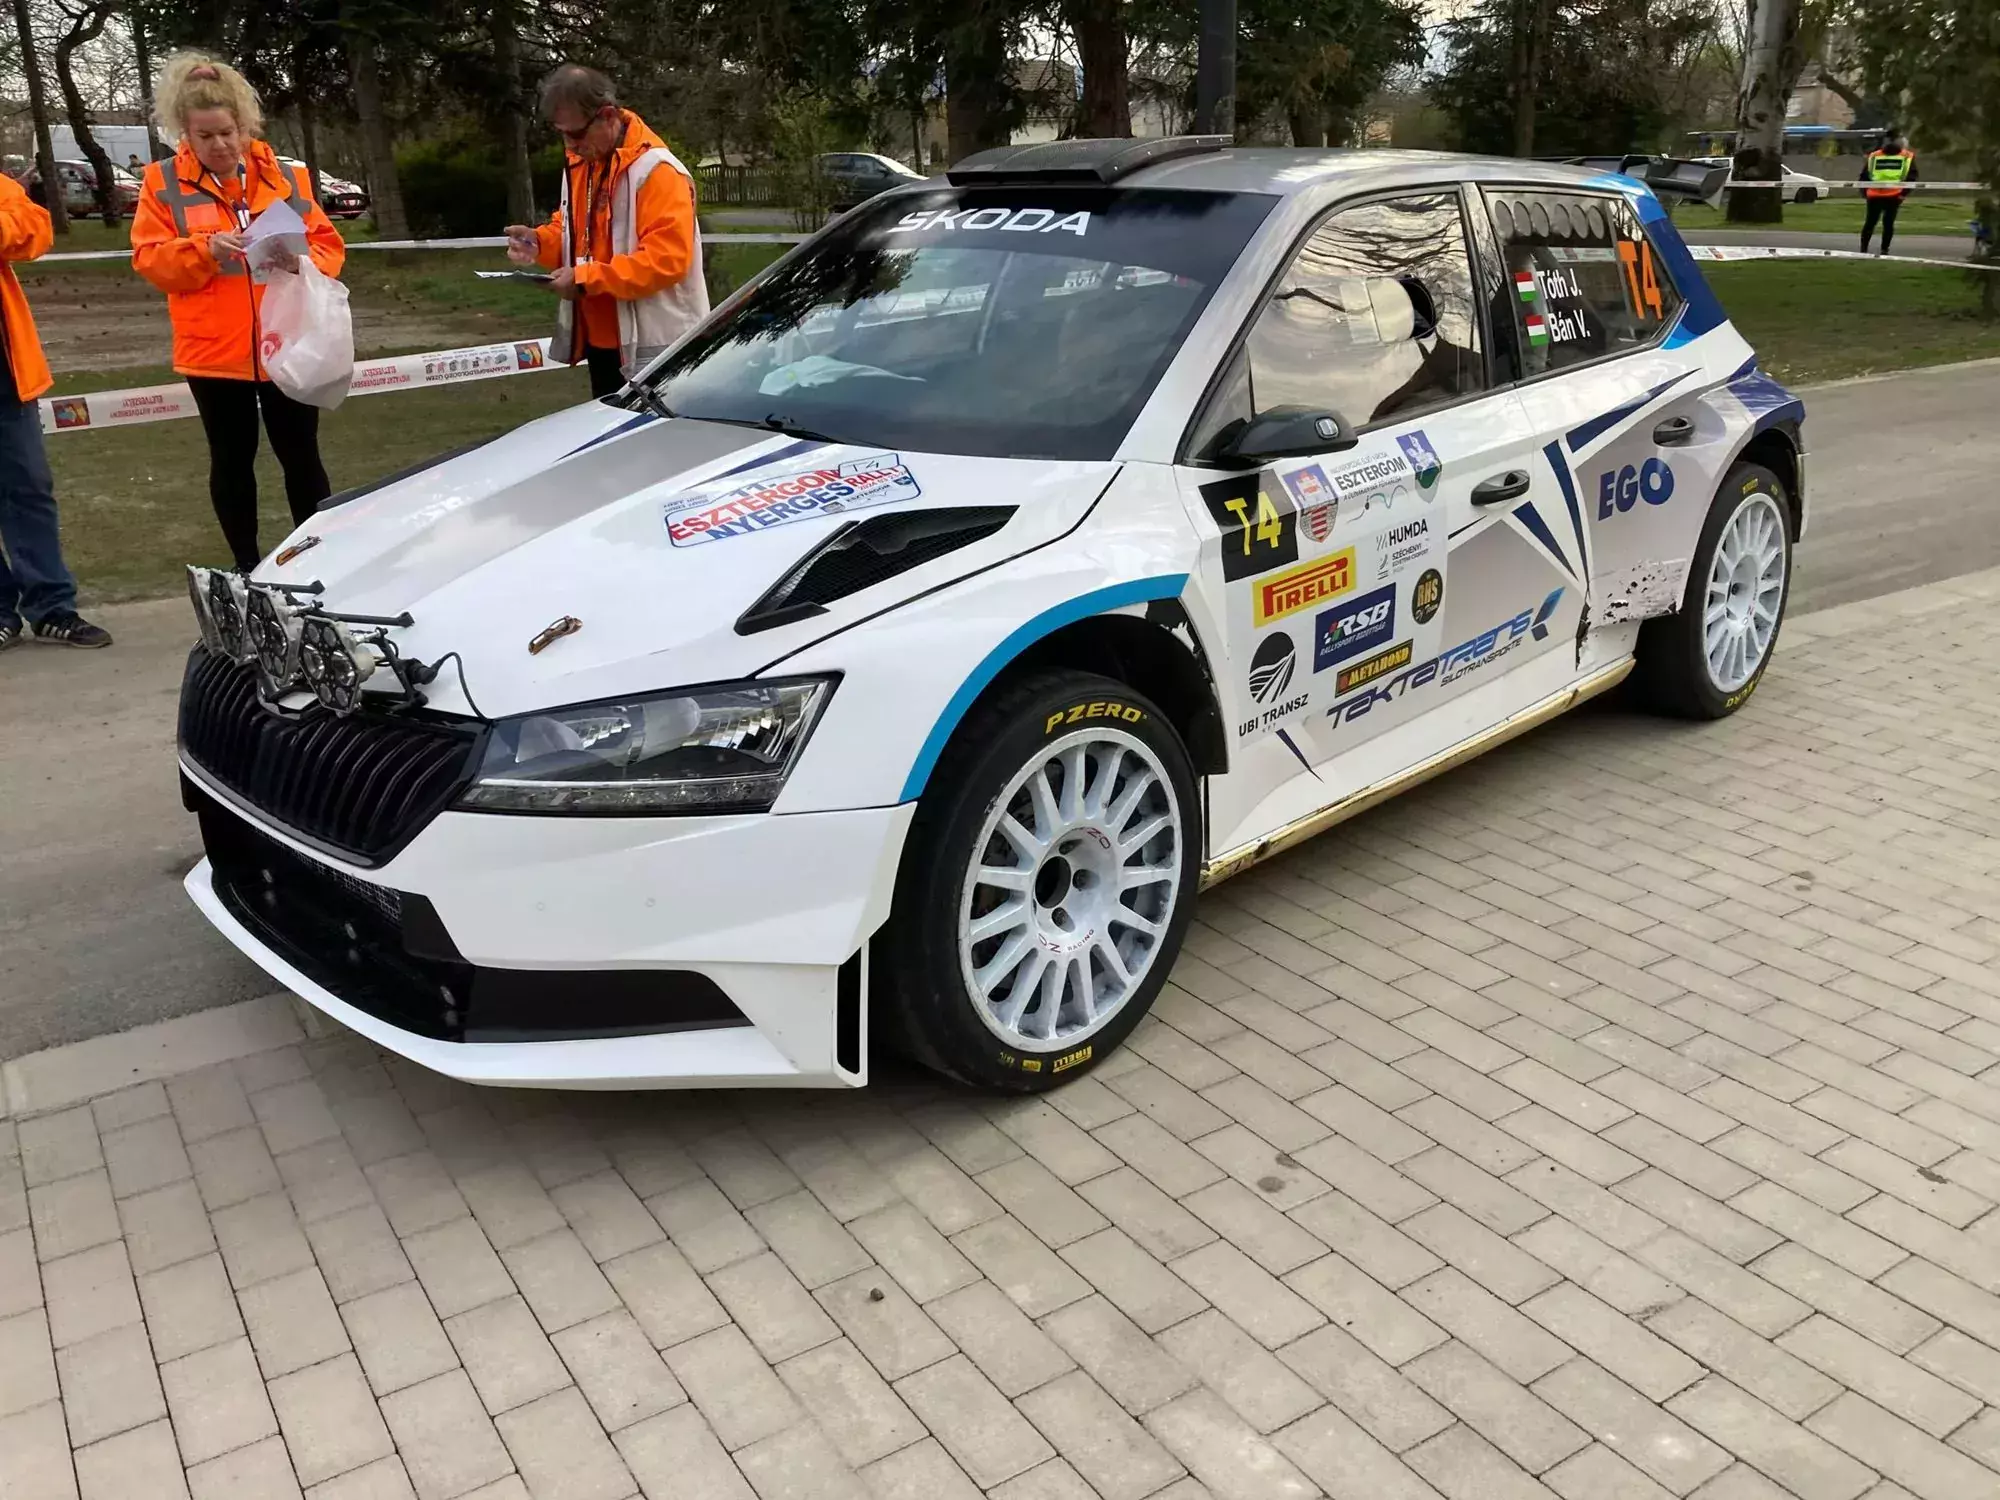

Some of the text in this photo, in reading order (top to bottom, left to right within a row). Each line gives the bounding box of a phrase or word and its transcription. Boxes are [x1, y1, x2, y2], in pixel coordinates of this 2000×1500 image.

[1536, 267, 1583, 301] Tóth J.
[1617, 240, 1663, 320] T4
[1549, 308, 1591, 343] Bán V.
[1335, 456, 1408, 491] ESZTERGOM
[1598, 457, 1675, 521] EGO
[704, 482, 855, 540] NYERGES
[1223, 490, 1282, 556] T4
[1389, 518, 1428, 546] HUMDA
[1262, 557, 1349, 618] PIRELLI
[1337, 600, 1392, 636] RSB
[1440, 636, 1523, 688] SILOTRANSPORTE
[1239, 693, 1309, 737] UBI TRANSZ
